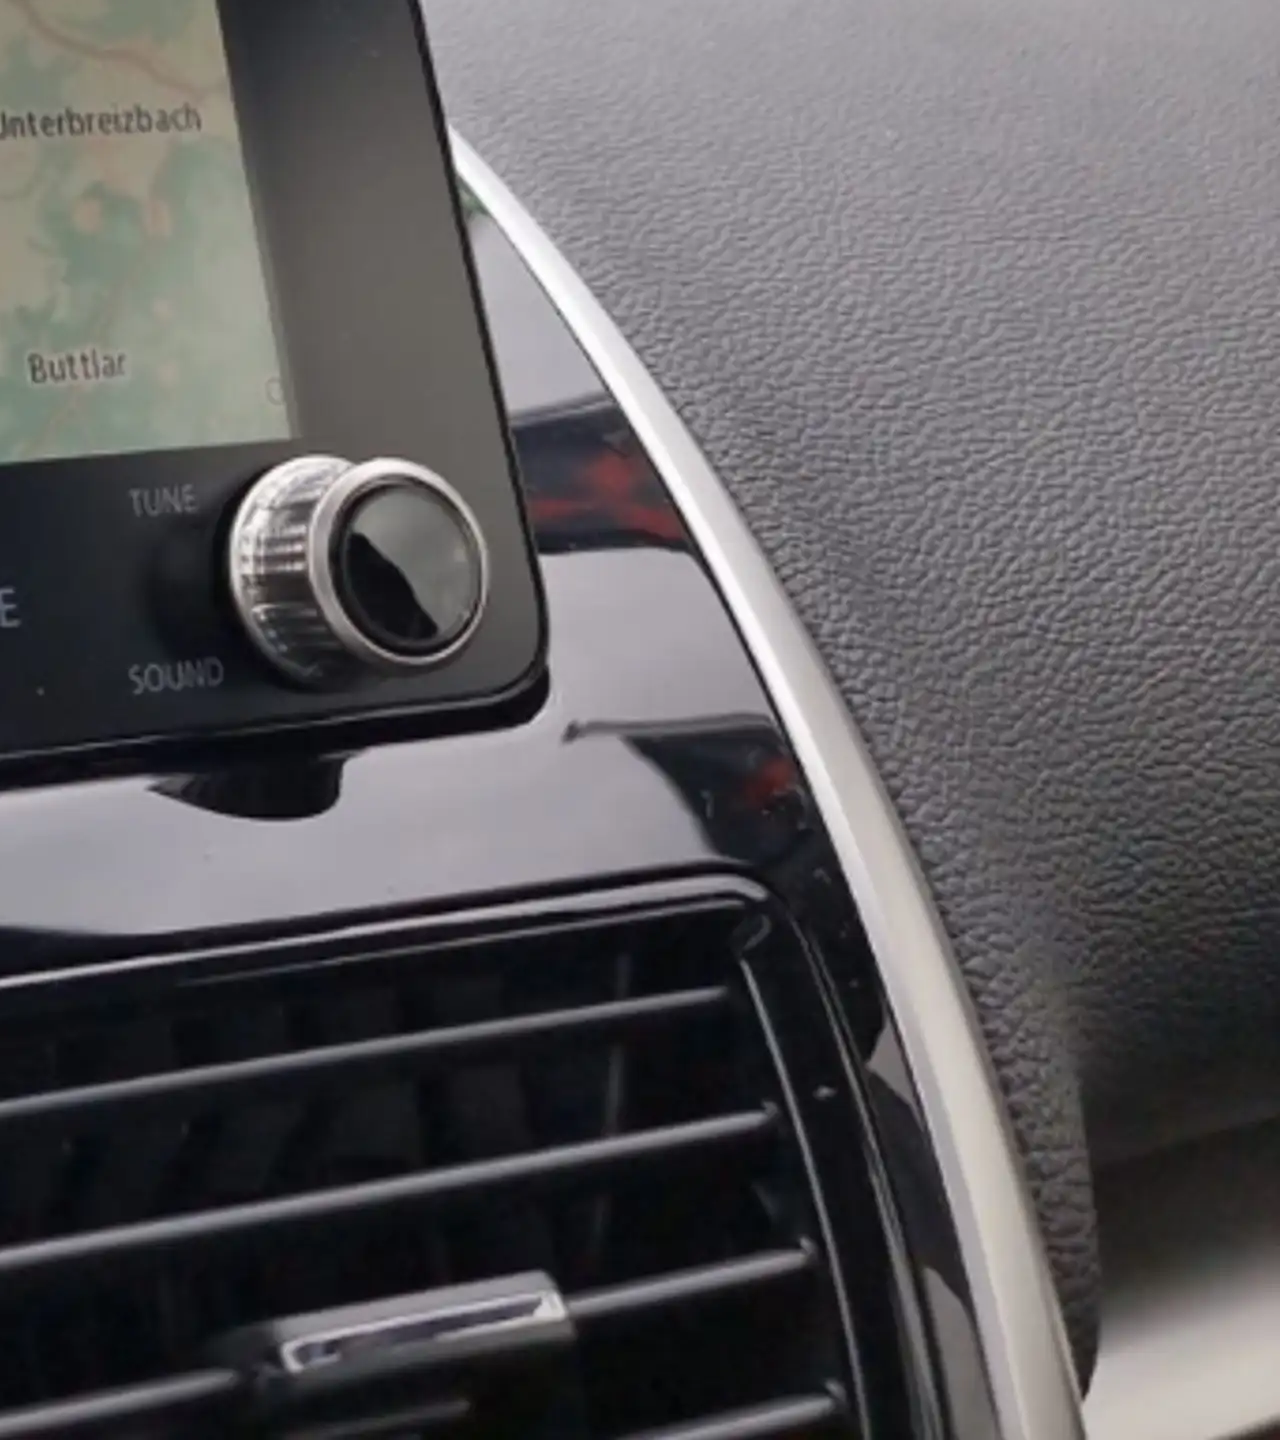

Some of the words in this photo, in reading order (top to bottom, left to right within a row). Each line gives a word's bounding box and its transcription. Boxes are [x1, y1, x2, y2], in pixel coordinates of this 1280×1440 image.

[28, 353, 126, 385] Buttlar
[129, 484, 199, 516] TUNE
[128, 657, 225, 695] SOUND
